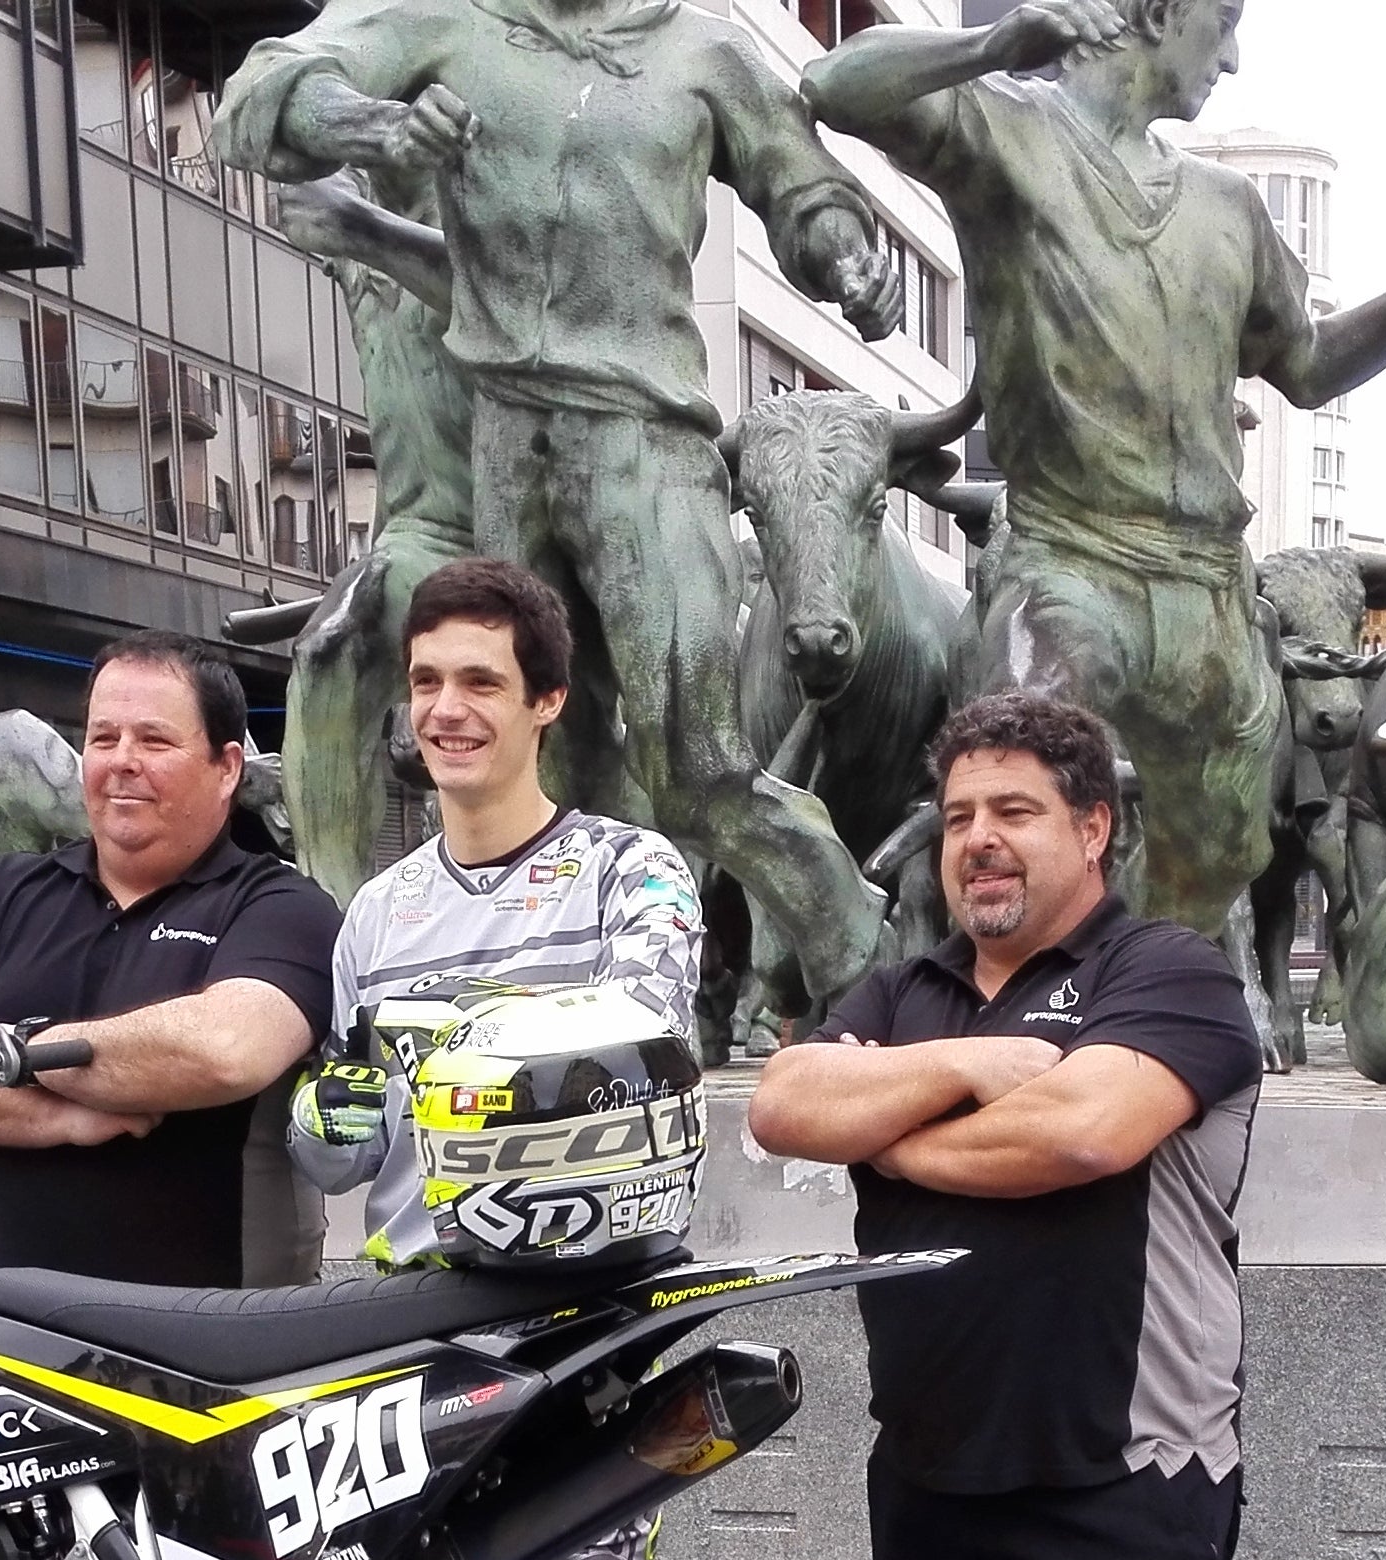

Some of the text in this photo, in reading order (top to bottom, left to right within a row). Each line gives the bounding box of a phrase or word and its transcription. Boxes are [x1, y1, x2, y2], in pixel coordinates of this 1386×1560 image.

[482, 1094, 507, 1106] SAND
[613, 1170, 685, 1201] VALENTIN
[610, 1186, 684, 1238] 920
[651, 1271, 796, 1307] flygroupnet.com
[251, 1374, 431, 1559] 920
